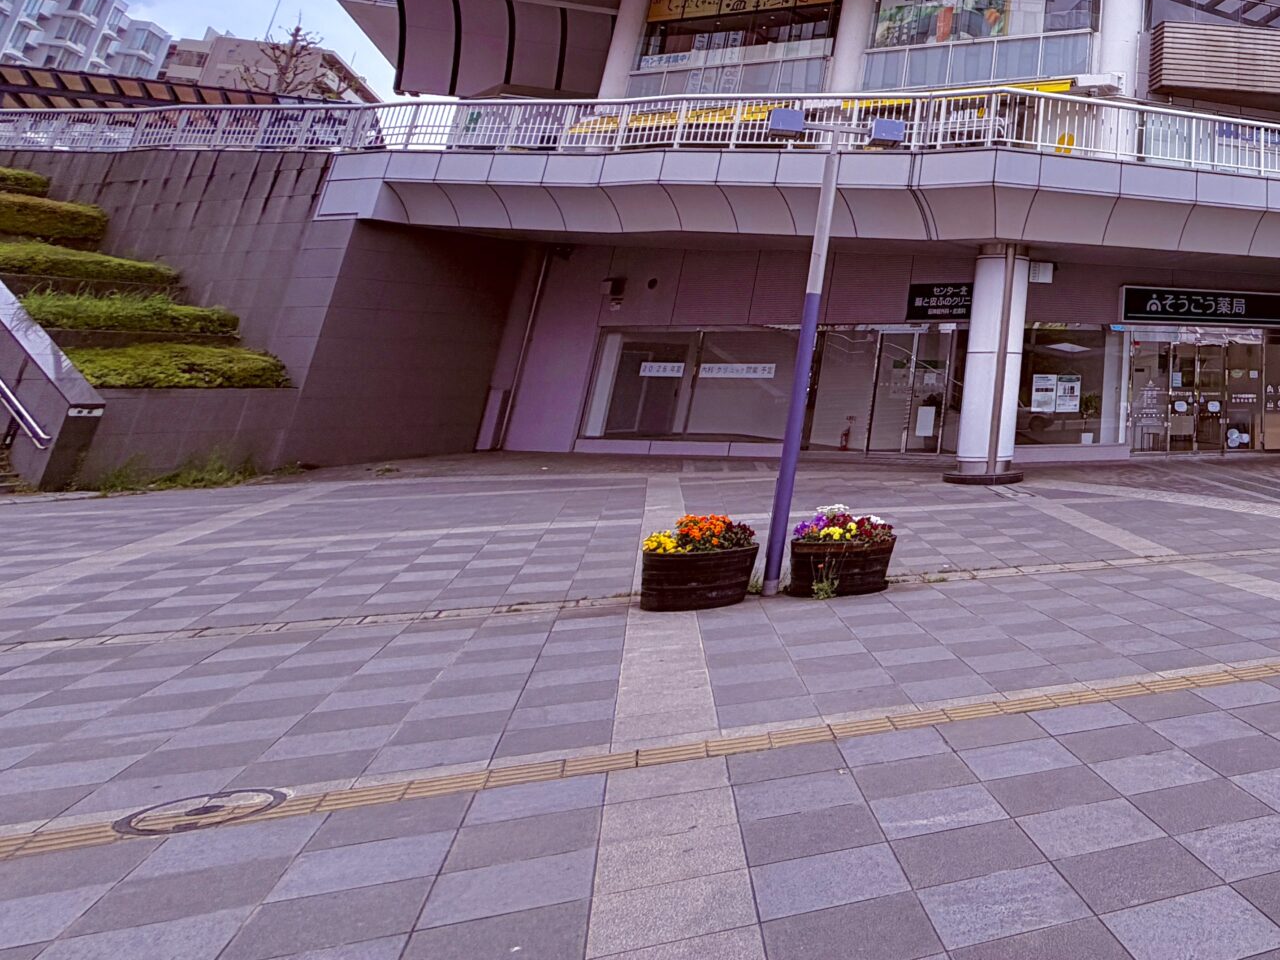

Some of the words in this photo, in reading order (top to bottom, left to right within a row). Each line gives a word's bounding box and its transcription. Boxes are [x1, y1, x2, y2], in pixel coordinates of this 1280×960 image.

[933, 286, 968, 296] センター北
[1161, 294, 1246, 315] そうごう薬局
